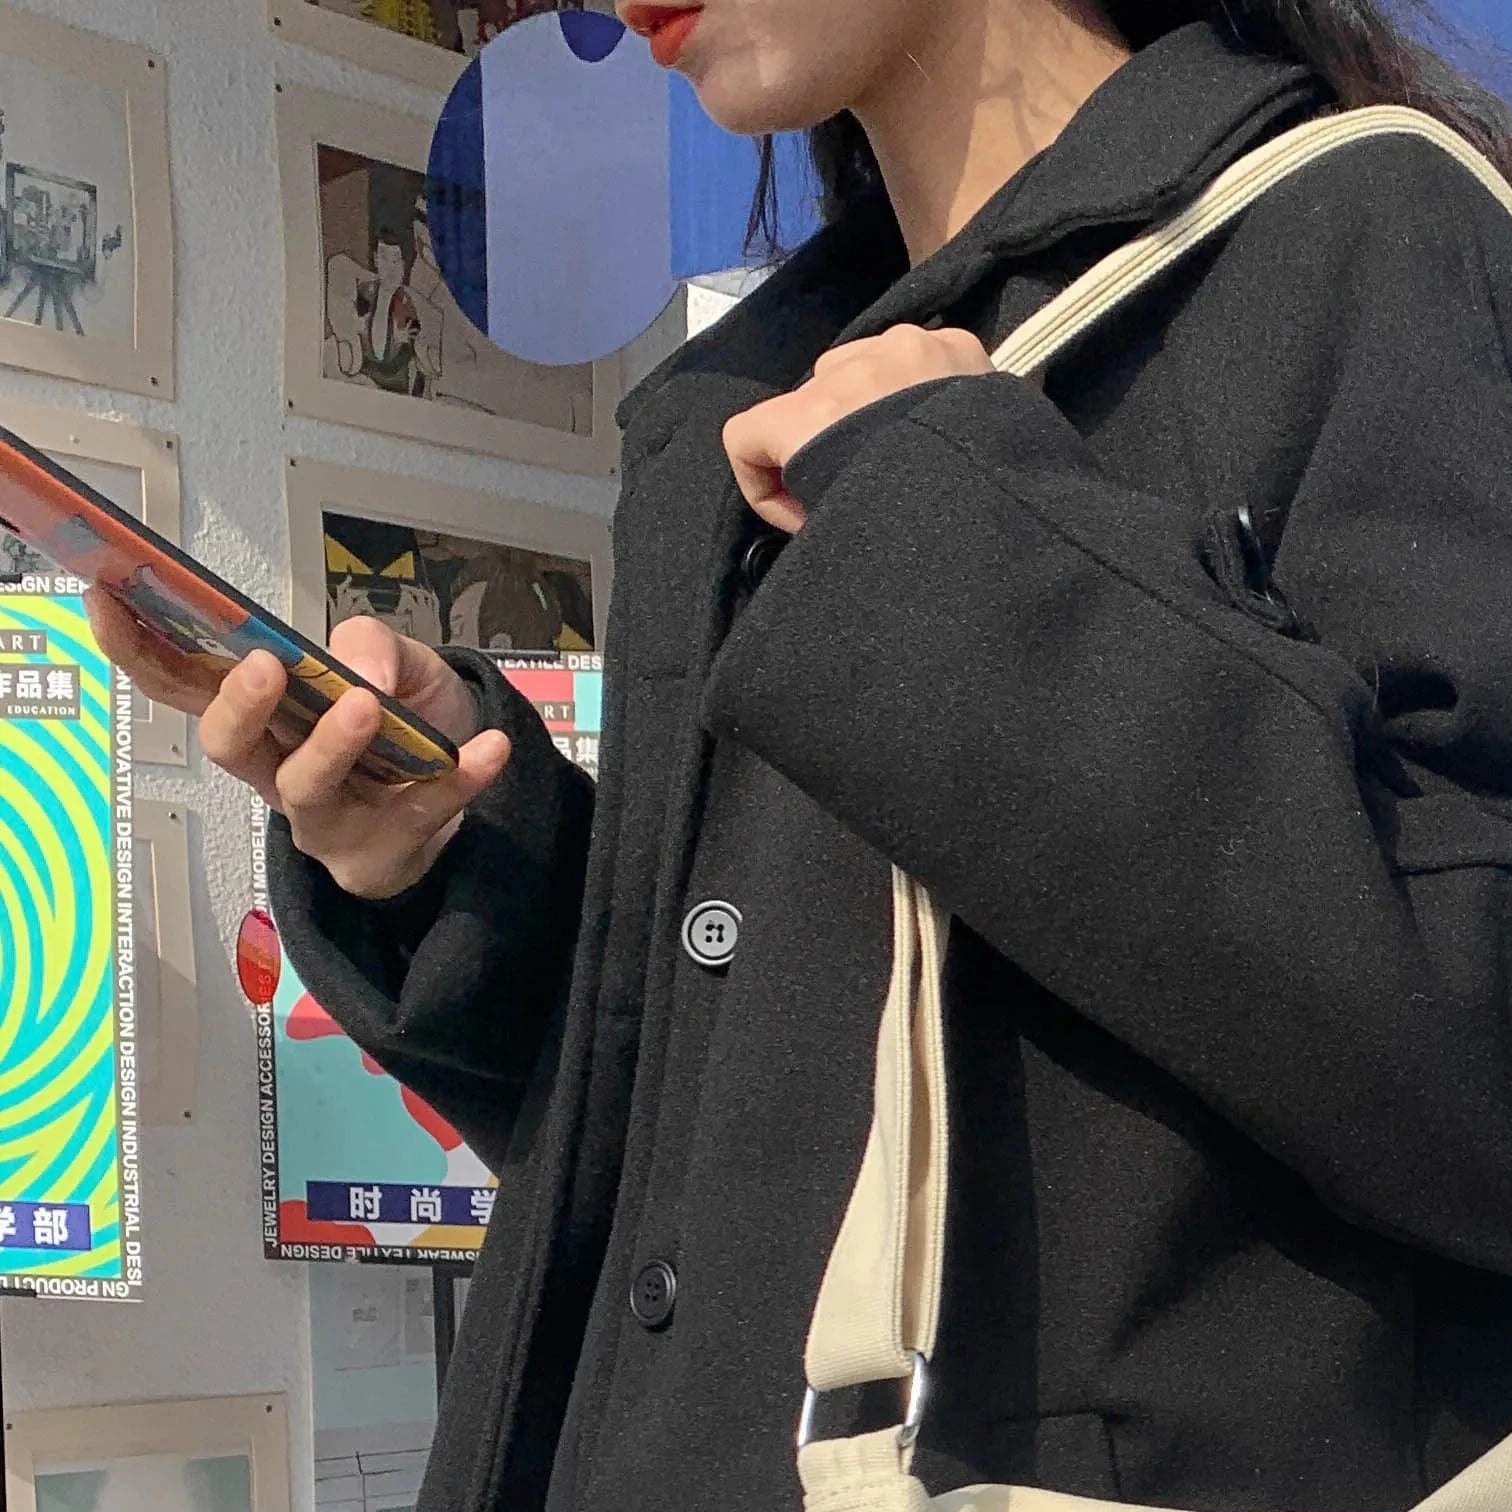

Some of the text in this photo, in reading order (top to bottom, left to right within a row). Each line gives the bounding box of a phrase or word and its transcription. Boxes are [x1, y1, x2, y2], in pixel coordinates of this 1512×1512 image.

[7, 705, 76, 716] EDUCATION
[116, 695, 132, 818] INNOVATIVE
[116, 822, 133, 899] DESIGN
[250, 794, 266, 889] MODELING
[117, 902, 136, 1037] INTERACTION
[119, 1041, 137, 1116] DESIGN
[260, 1103, 276, 1163] DESIGN
[121, 1119, 140, 1238] INDUSTRIAL
[262, 1169, 278, 1248] JEWELRY
[126, 1241, 142, 1286] DESI
[280, 1244, 342, 1259] DESIGN
